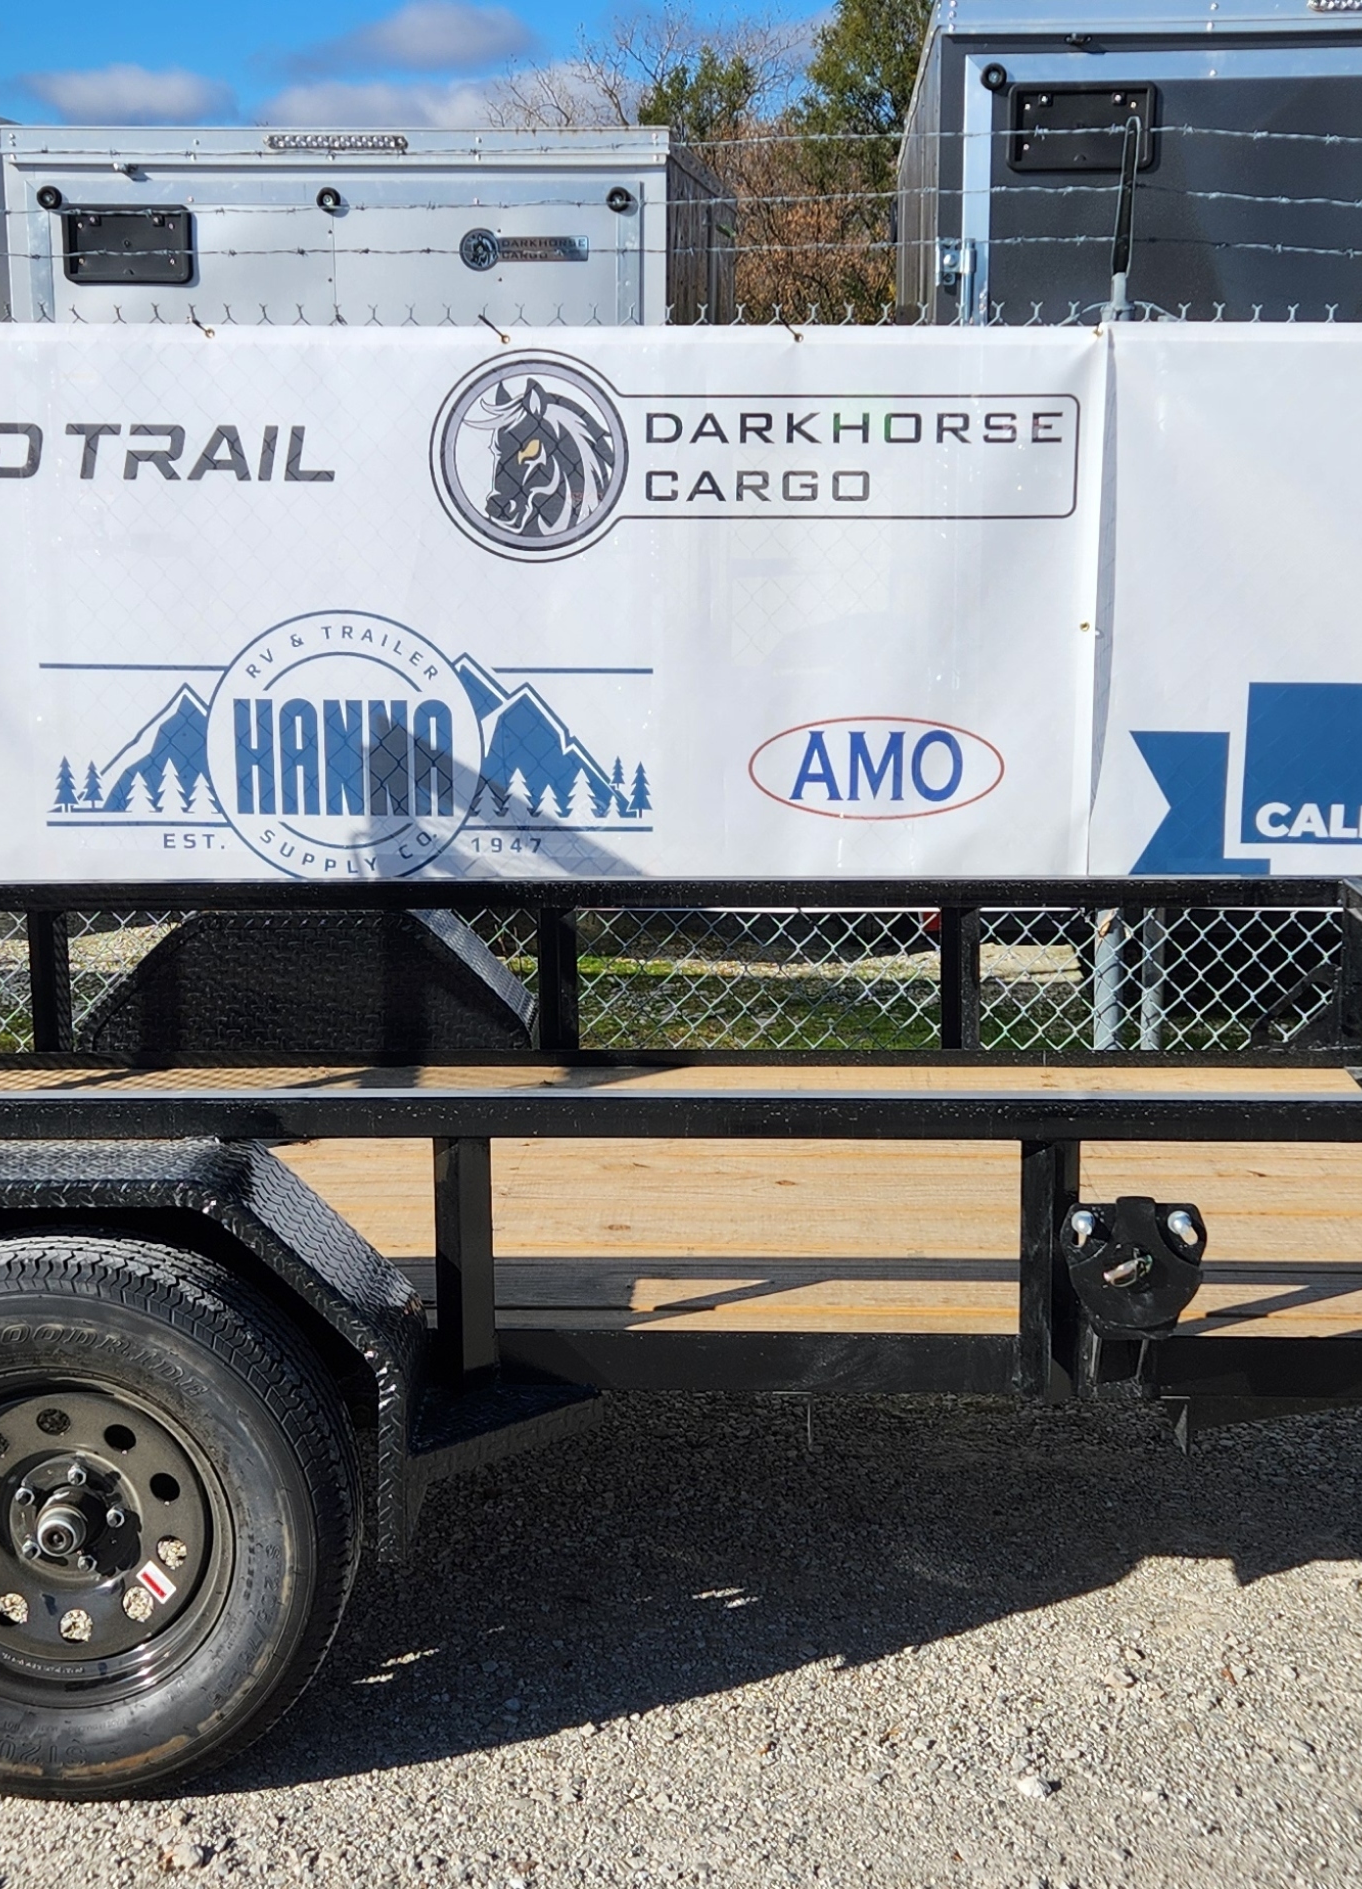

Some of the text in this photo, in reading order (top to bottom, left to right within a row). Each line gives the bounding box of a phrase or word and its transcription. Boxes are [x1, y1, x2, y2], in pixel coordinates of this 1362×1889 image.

[501, 238, 586, 248] DARKHORSE
[501, 250, 548, 260] CARGO
[644, 411, 1064, 445] DARKHORSE
[65, 422, 335, 483] TRAIL
[644, 470, 871, 503] CARGO
[245, 625, 439, 681] RV & TRAILER
[233, 697, 455, 817] HANNA
[789, 730, 965, 802] AMO
[162, 832, 226, 850] EST.
[259, 828, 438, 874] SUPPLY CO.
[470, 836, 543, 854] 1947
